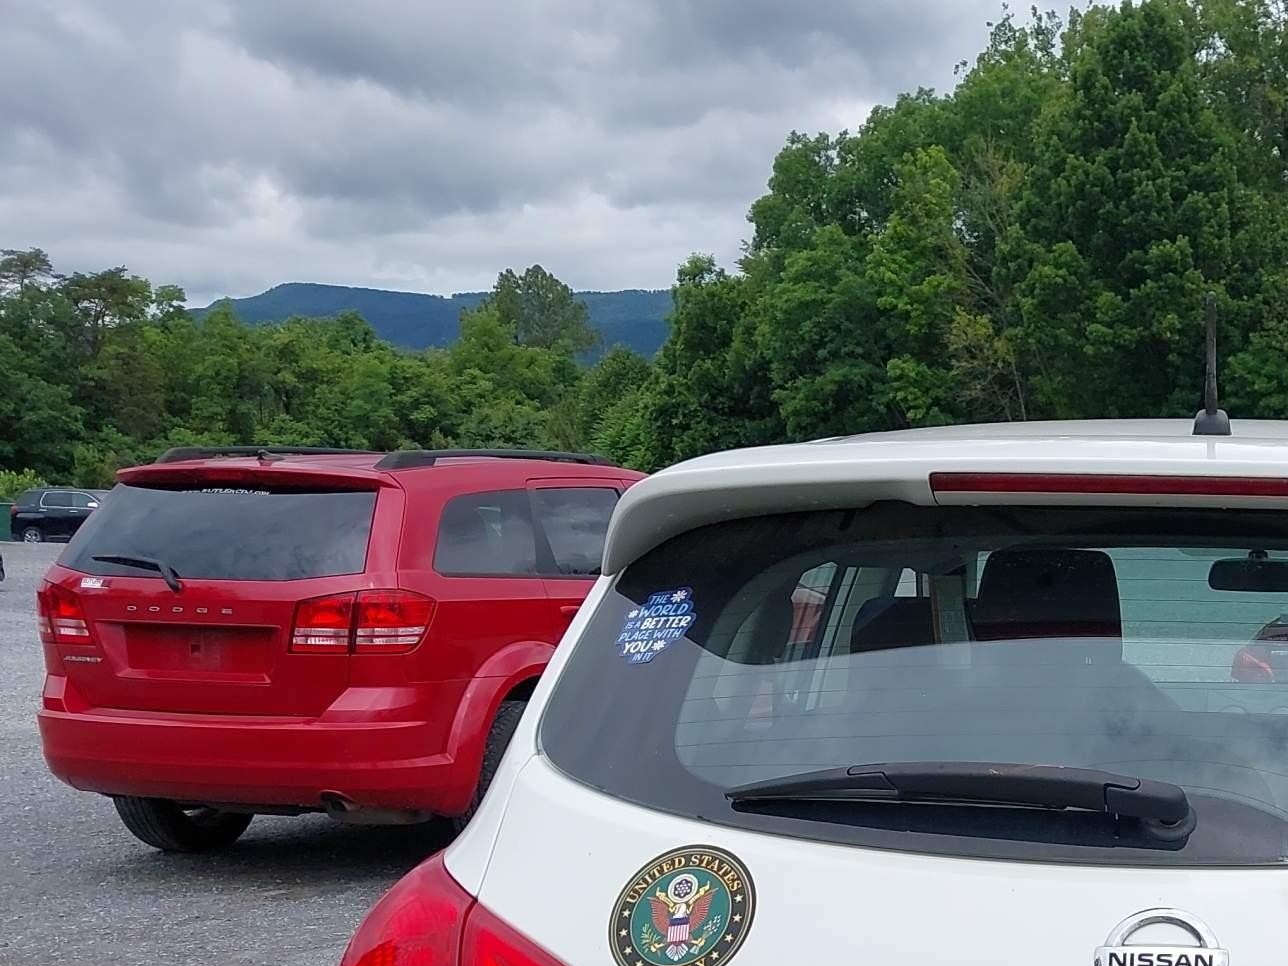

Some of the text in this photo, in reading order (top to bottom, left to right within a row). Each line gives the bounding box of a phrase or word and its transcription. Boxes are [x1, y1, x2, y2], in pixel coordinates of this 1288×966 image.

[650, 595, 669, 604] THE
[127, 605, 233, 615] DODGE
[639, 604, 688, 617] WORLD
[635, 621, 641, 629] A
[640, 616, 691, 629] BETTER
[618, 629, 682, 641] PLACE WITH
[623, 641, 653, 653] YOU
[632, 652, 654, 661] IN IT
[625, 854, 743, 904] UNITED STATES
